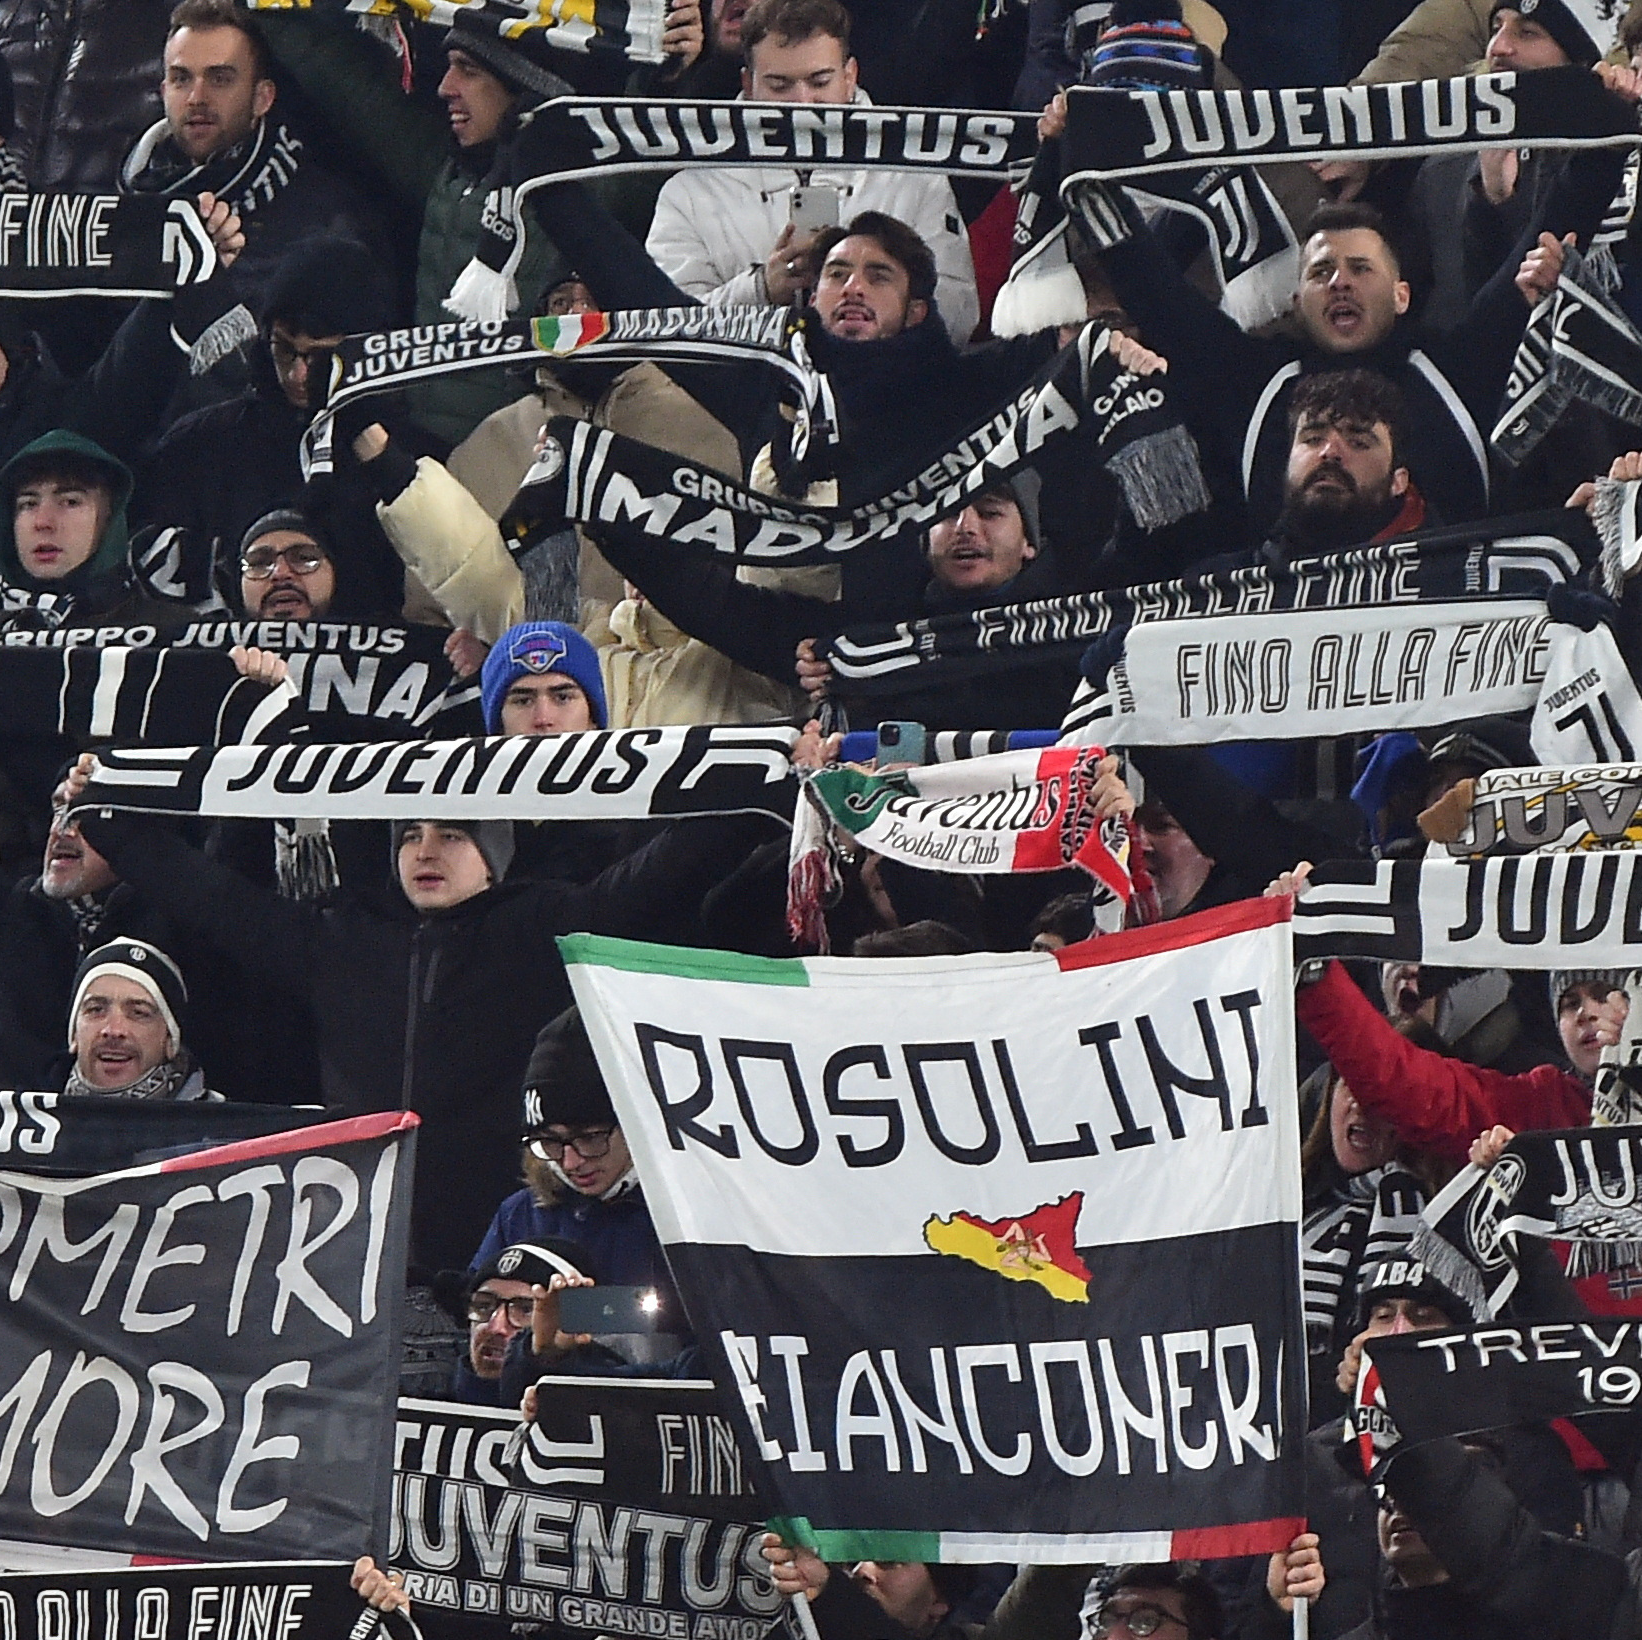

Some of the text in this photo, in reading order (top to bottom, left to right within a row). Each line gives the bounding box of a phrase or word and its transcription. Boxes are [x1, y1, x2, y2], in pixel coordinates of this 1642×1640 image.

[569, 108, 1017, 164] JUVENTUS
[1129, 71, 1518, 160] JUVENTUS
[363, 317, 504, 357] GRUPPO
[607, 305, 789, 347] MADUNINA
[345, 330, 524, 385] JUVENTUS
[851, 385, 1038, 523] JUVENTUS
[971, 591, 1114, 653] FINO
[1289, 542, 1422, 609] FINE
[174, 621, 407, 656] JUVENTUS
[1175, 614, 1561, 719] FINO ALLA FINE
[1543, 667, 1602, 714] JUVENTUS
[226, 730, 658, 797] JUVENTUS
[847, 774, 1063, 835] Juventus
[880, 822, 1002, 869] Football Club
[632, 990, 1270, 1170] ROSOLINI
[656, 1413, 753, 1497] FIN
[387, 1470, 789, 1615] JUVENTUS
[464, 1586, 688, 1639] DI UN GRANDE
